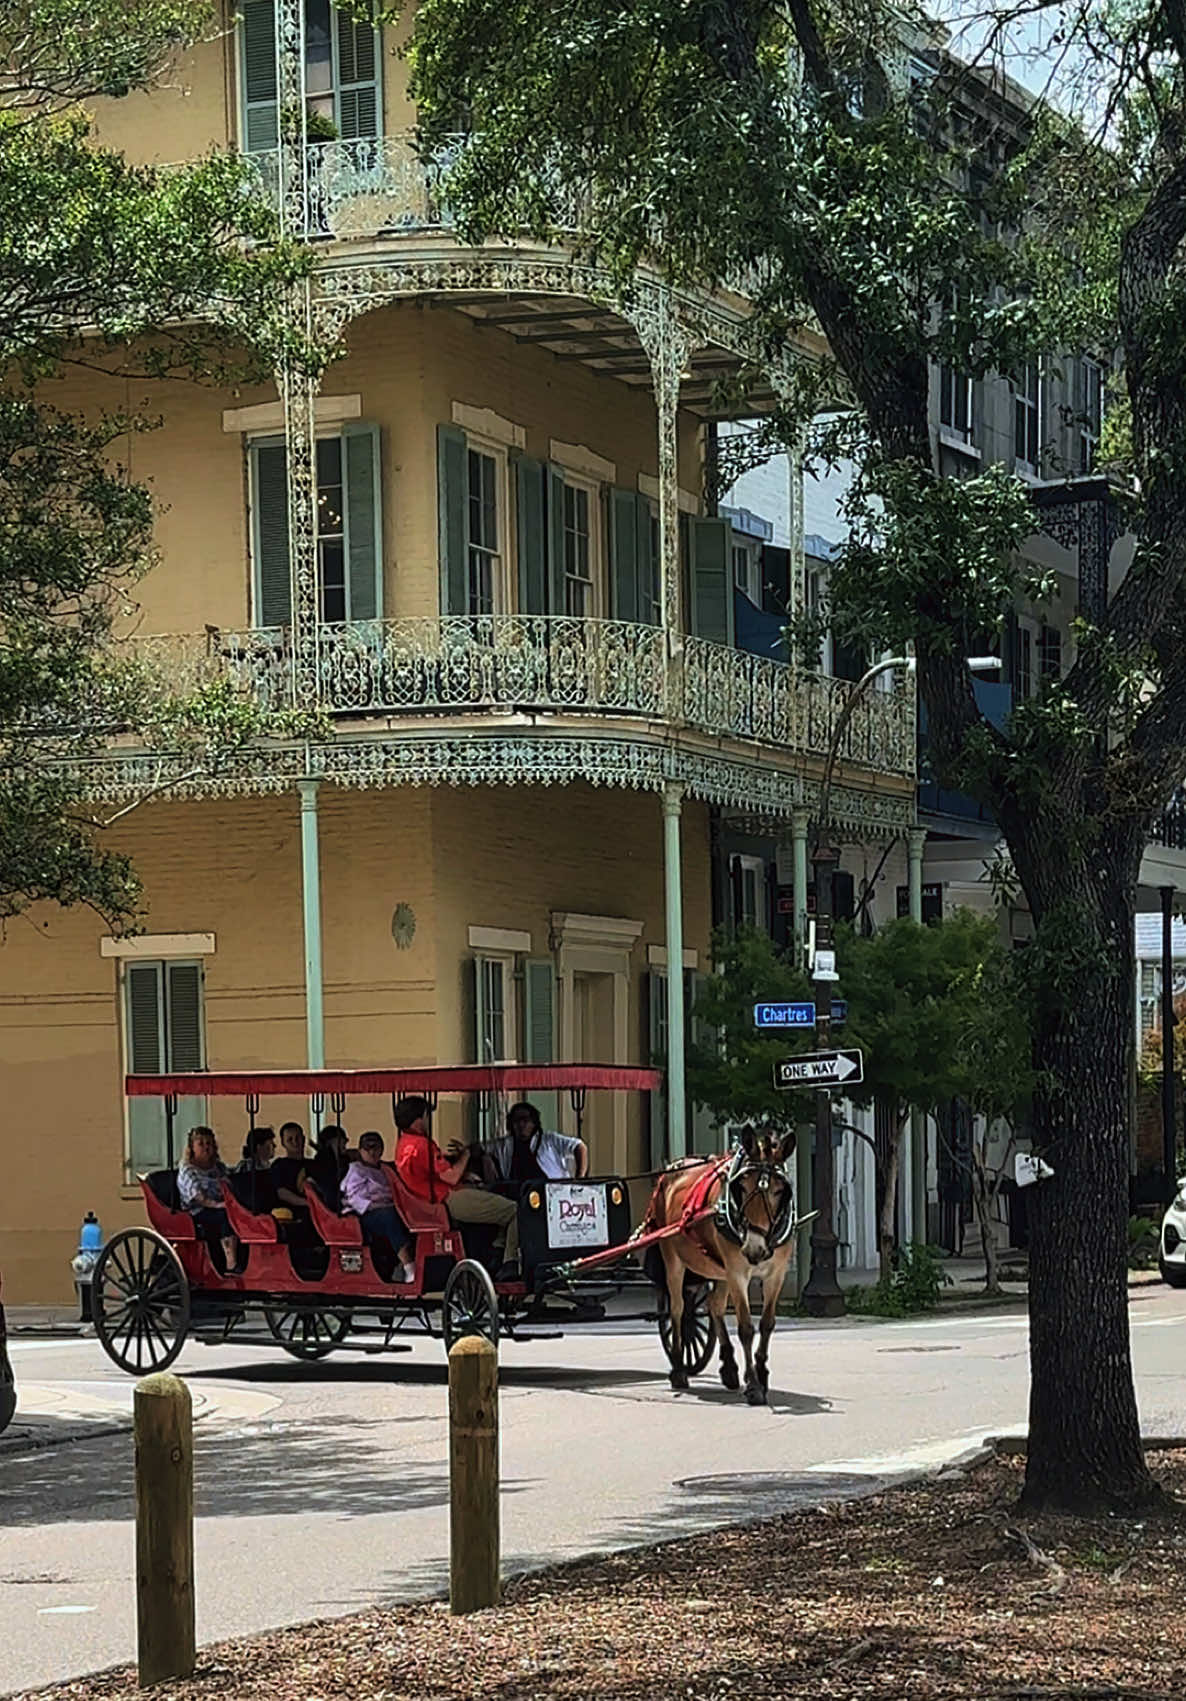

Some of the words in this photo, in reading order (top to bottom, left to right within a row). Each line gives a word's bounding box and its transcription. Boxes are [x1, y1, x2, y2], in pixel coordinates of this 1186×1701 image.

[762, 1007, 808, 1022] Chartres
[783, 1065, 808, 1078] ONE
[812, 1062, 836, 1075] WAY
[558, 1197, 596, 1221] Royal
